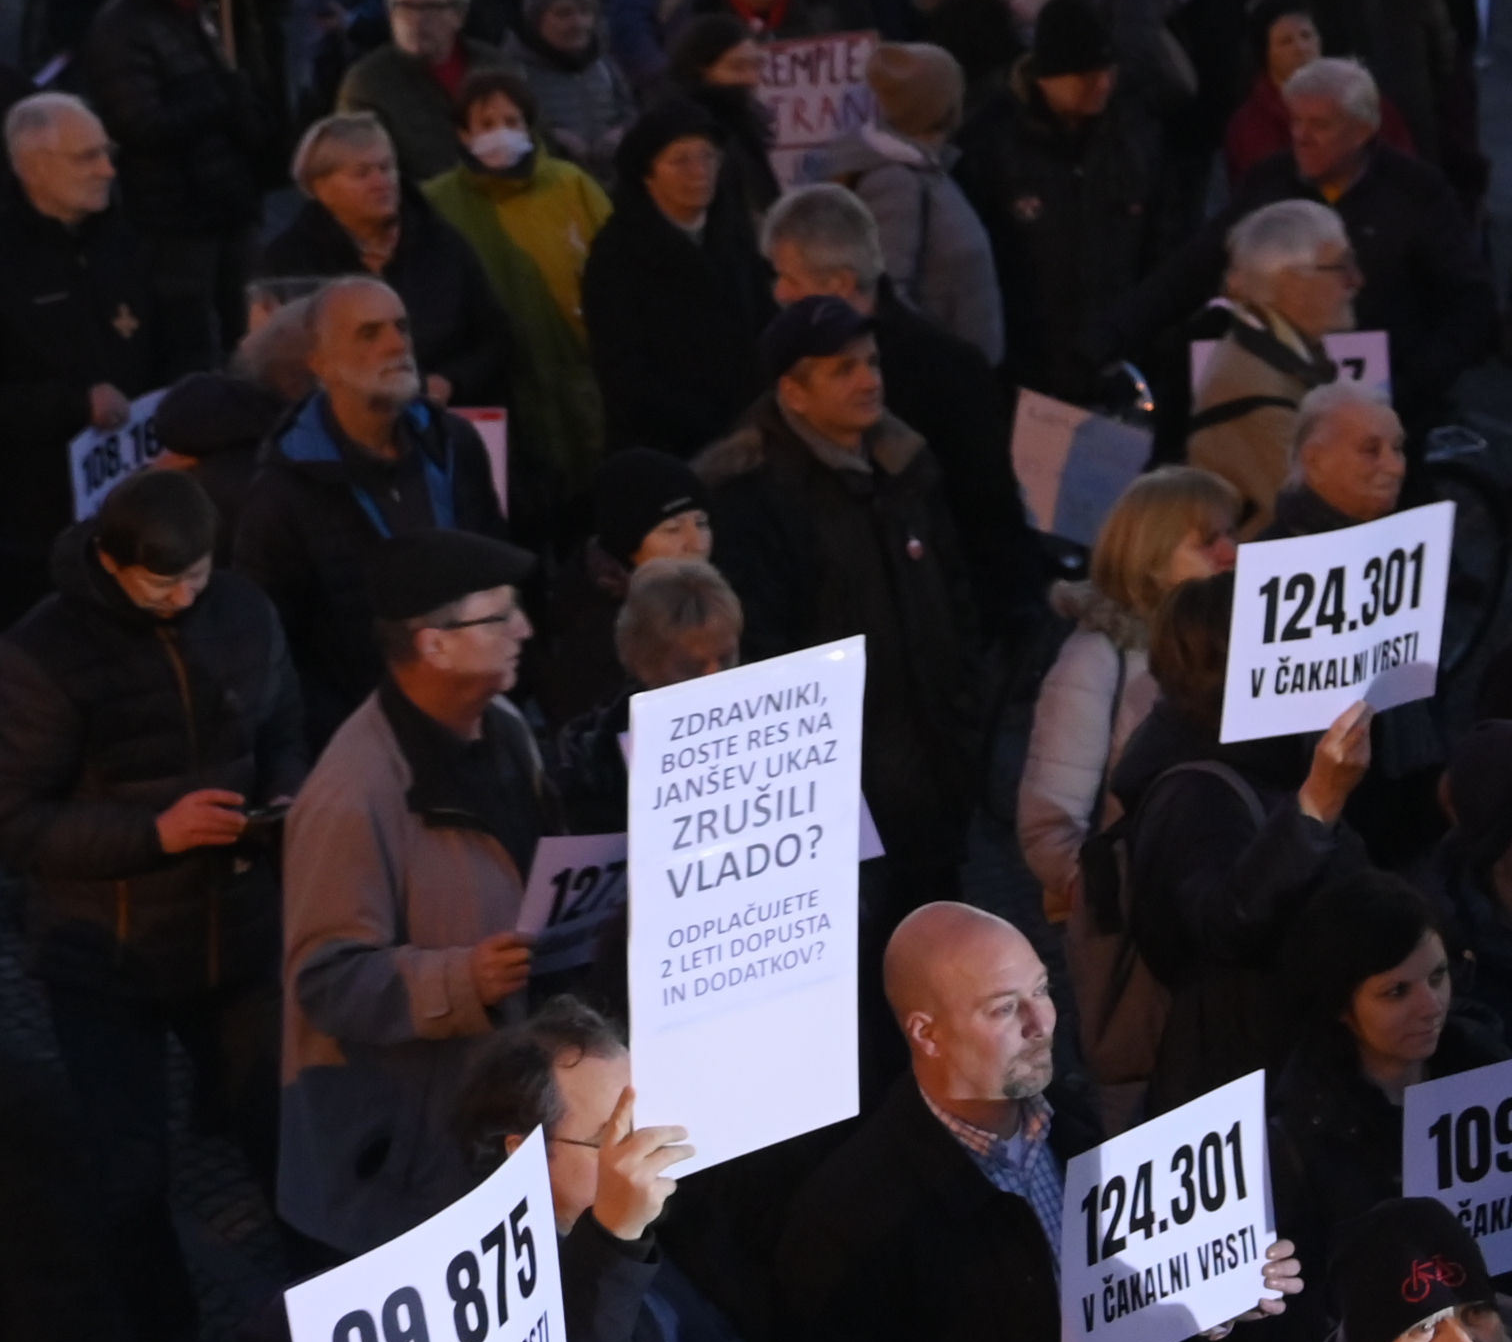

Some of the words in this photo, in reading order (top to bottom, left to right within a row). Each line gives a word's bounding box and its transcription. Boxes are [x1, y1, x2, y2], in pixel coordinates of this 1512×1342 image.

[83, 416, 162, 497] 108.16
[1259, 541, 1426, 645] 124.301
[1251, 667, 1265, 699] V
[1274, 649, 1369, 696] ČAKALNI
[1371, 631, 1420, 675] VRSTI
[661, 734, 739, 775] BOSTE
[747, 721, 790, 752] RES
[798, 711, 833, 740] NA
[670, 680, 829, 742] ZDRAVNIKI,
[651, 760, 758, 811] JANŠEV
[765, 739, 839, 780] UKAZ
[671, 780, 817, 852] ZRUŠILI
[666, 823, 825, 900] VLADO?
[660, 959, 673, 979] 2
[680, 942, 723, 974] LETI
[729, 912, 832, 958] DOPUSTA
[667, 888, 821, 950] ODPLAČUJETE
[662, 981, 686, 1007] IN
[693, 940, 826, 998] DODATKOV?
[1080, 1119, 1248, 1268] 124.301
[1081, 1292, 1096, 1334] V
[1102, 1251, 1191, 1325] ČAKALNI
[1196, 1223, 1259, 1282] VRSTI
